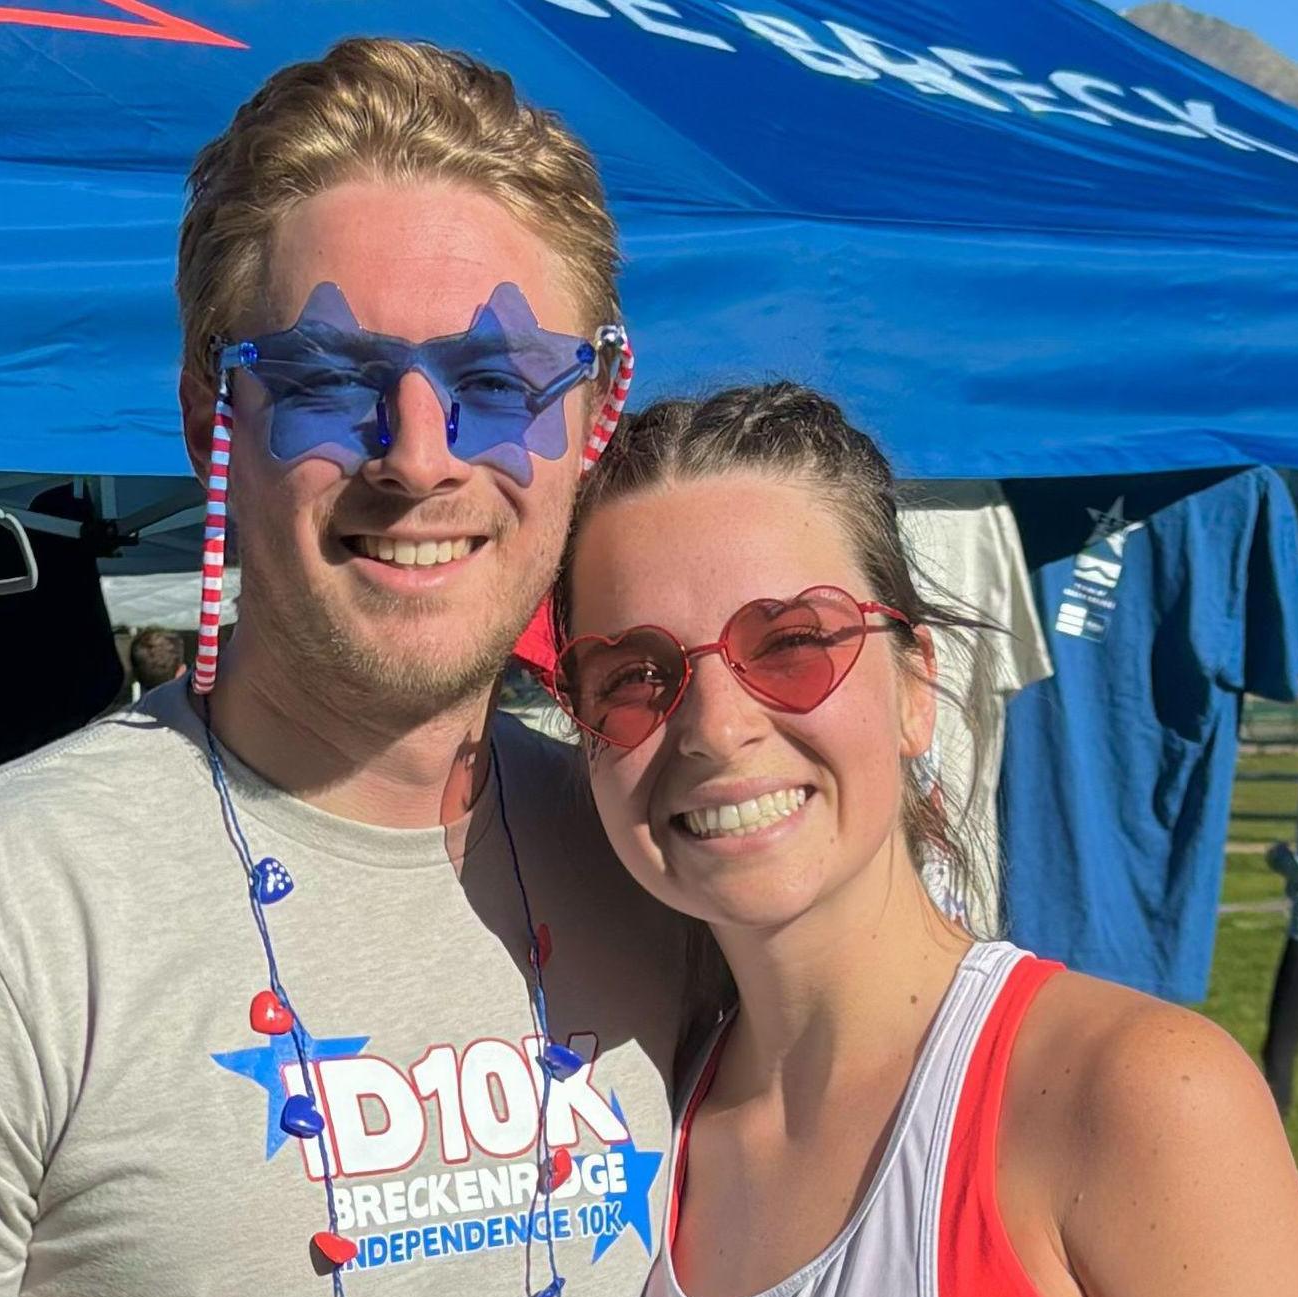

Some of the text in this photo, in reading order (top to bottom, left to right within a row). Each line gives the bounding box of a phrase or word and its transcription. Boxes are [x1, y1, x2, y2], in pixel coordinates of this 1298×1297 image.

[280, 1032, 631, 1182] ID10K
[331, 1153, 628, 1231] BRECKENRDGE
[341, 1202, 626, 1272] NDEPENDENCE 10K
